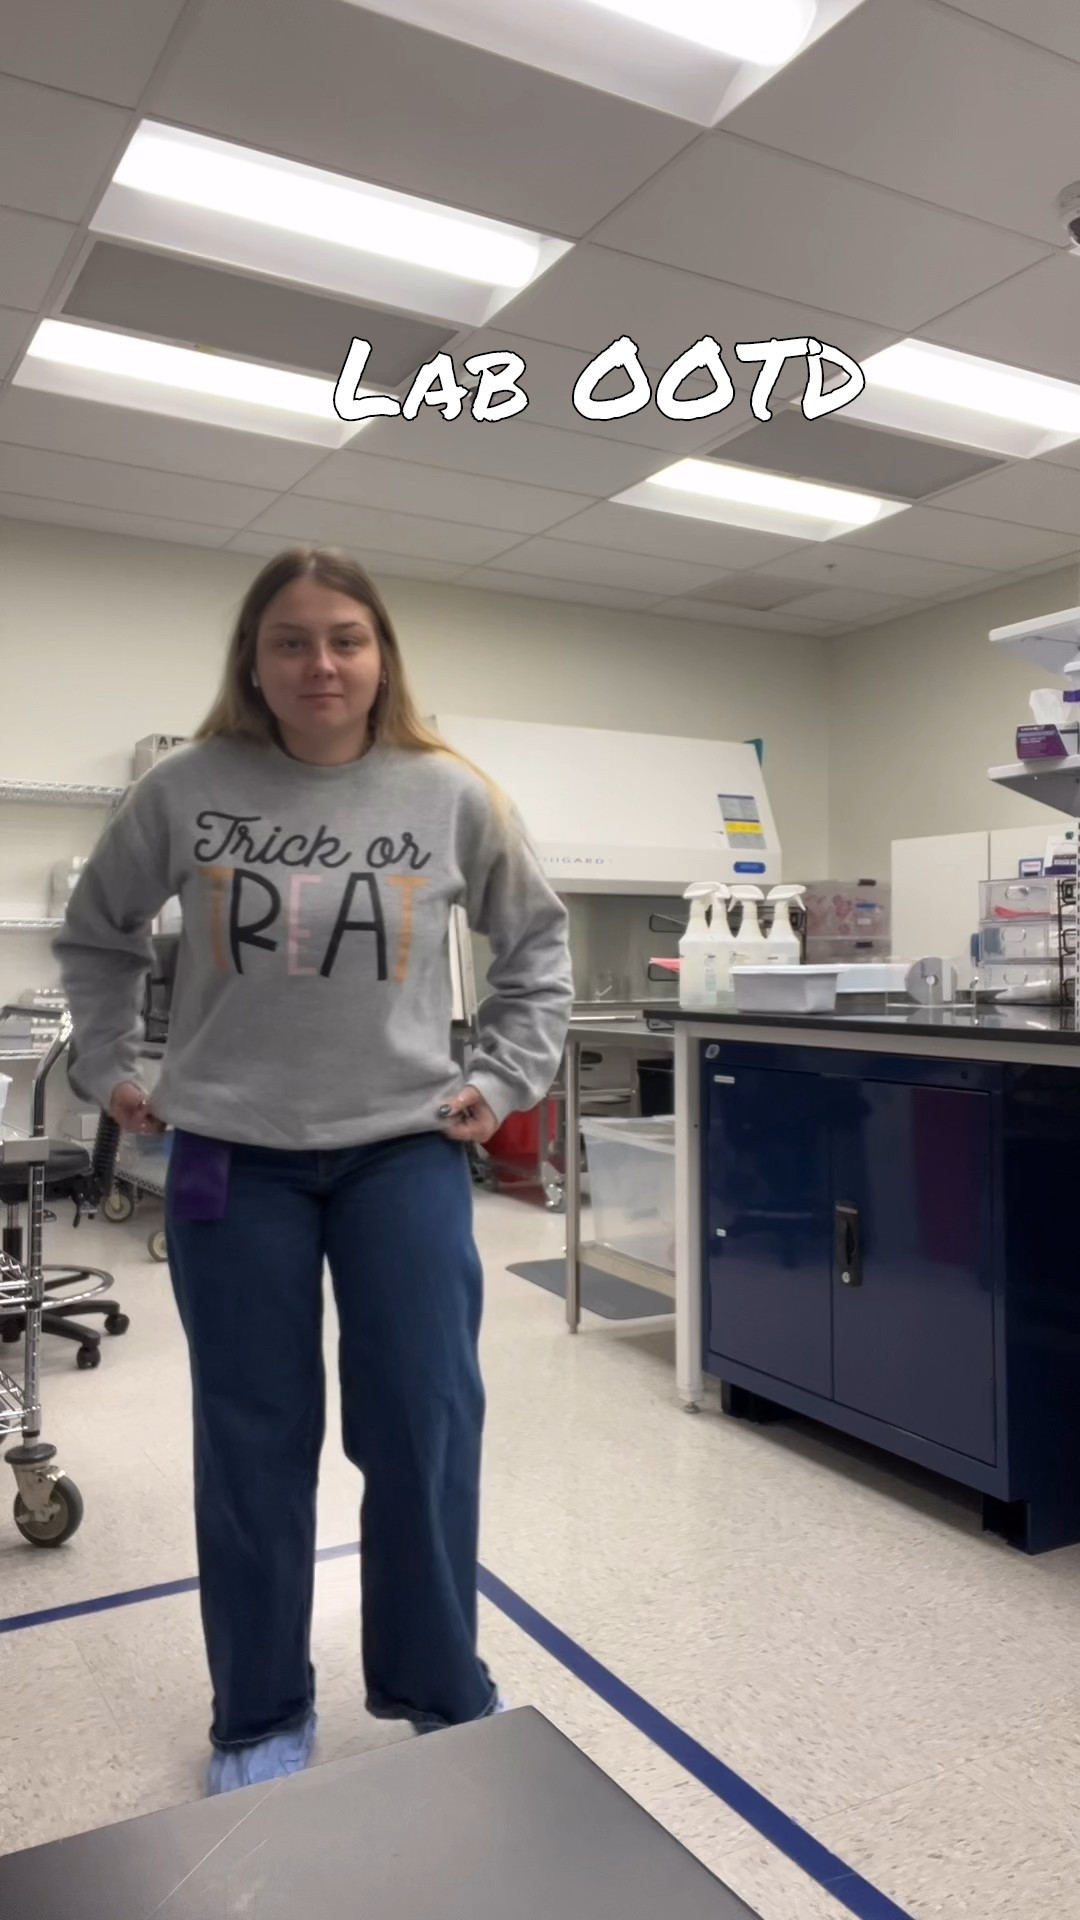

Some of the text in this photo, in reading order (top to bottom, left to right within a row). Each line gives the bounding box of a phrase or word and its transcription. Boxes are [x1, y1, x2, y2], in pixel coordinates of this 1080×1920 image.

[194, 811, 431, 869] Trick or
[197, 866, 431, 984] TREAT
